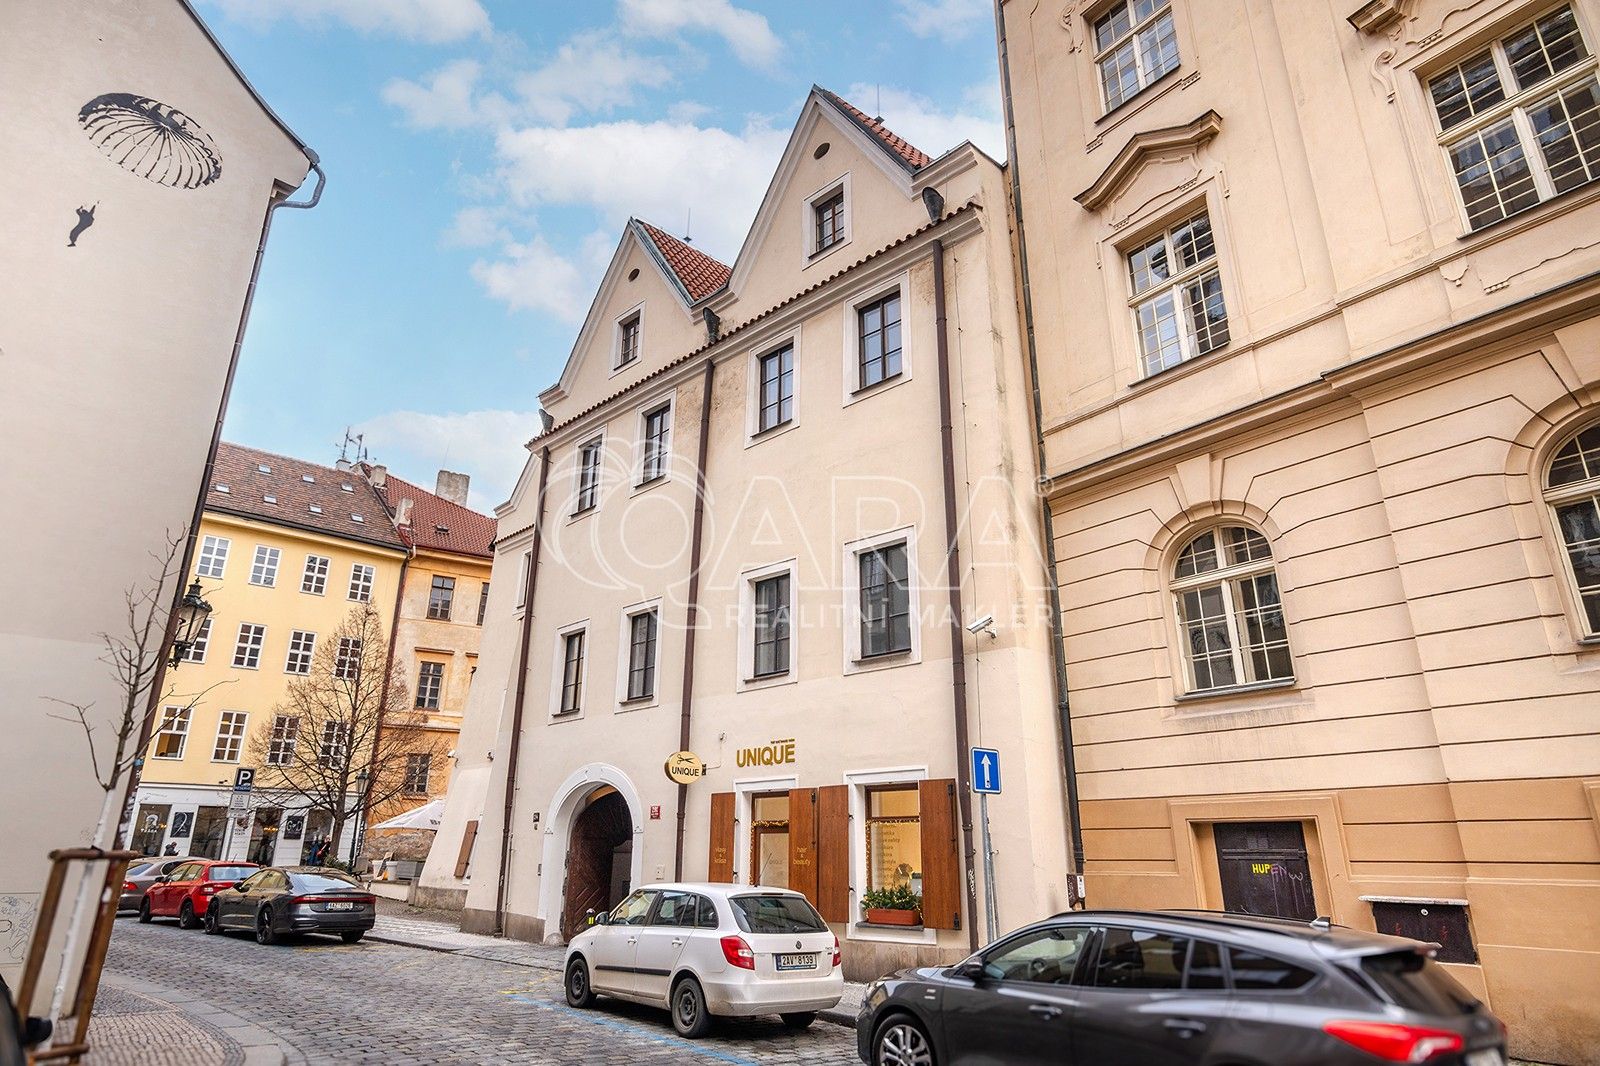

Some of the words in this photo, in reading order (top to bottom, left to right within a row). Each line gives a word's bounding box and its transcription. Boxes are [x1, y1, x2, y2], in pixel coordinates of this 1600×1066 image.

[736, 744, 795, 768] UNIQUE
[238, 770, 252, 786] P
[671, 766, 700, 777] UNIQUE
[782, 955, 794, 966] 2AV
